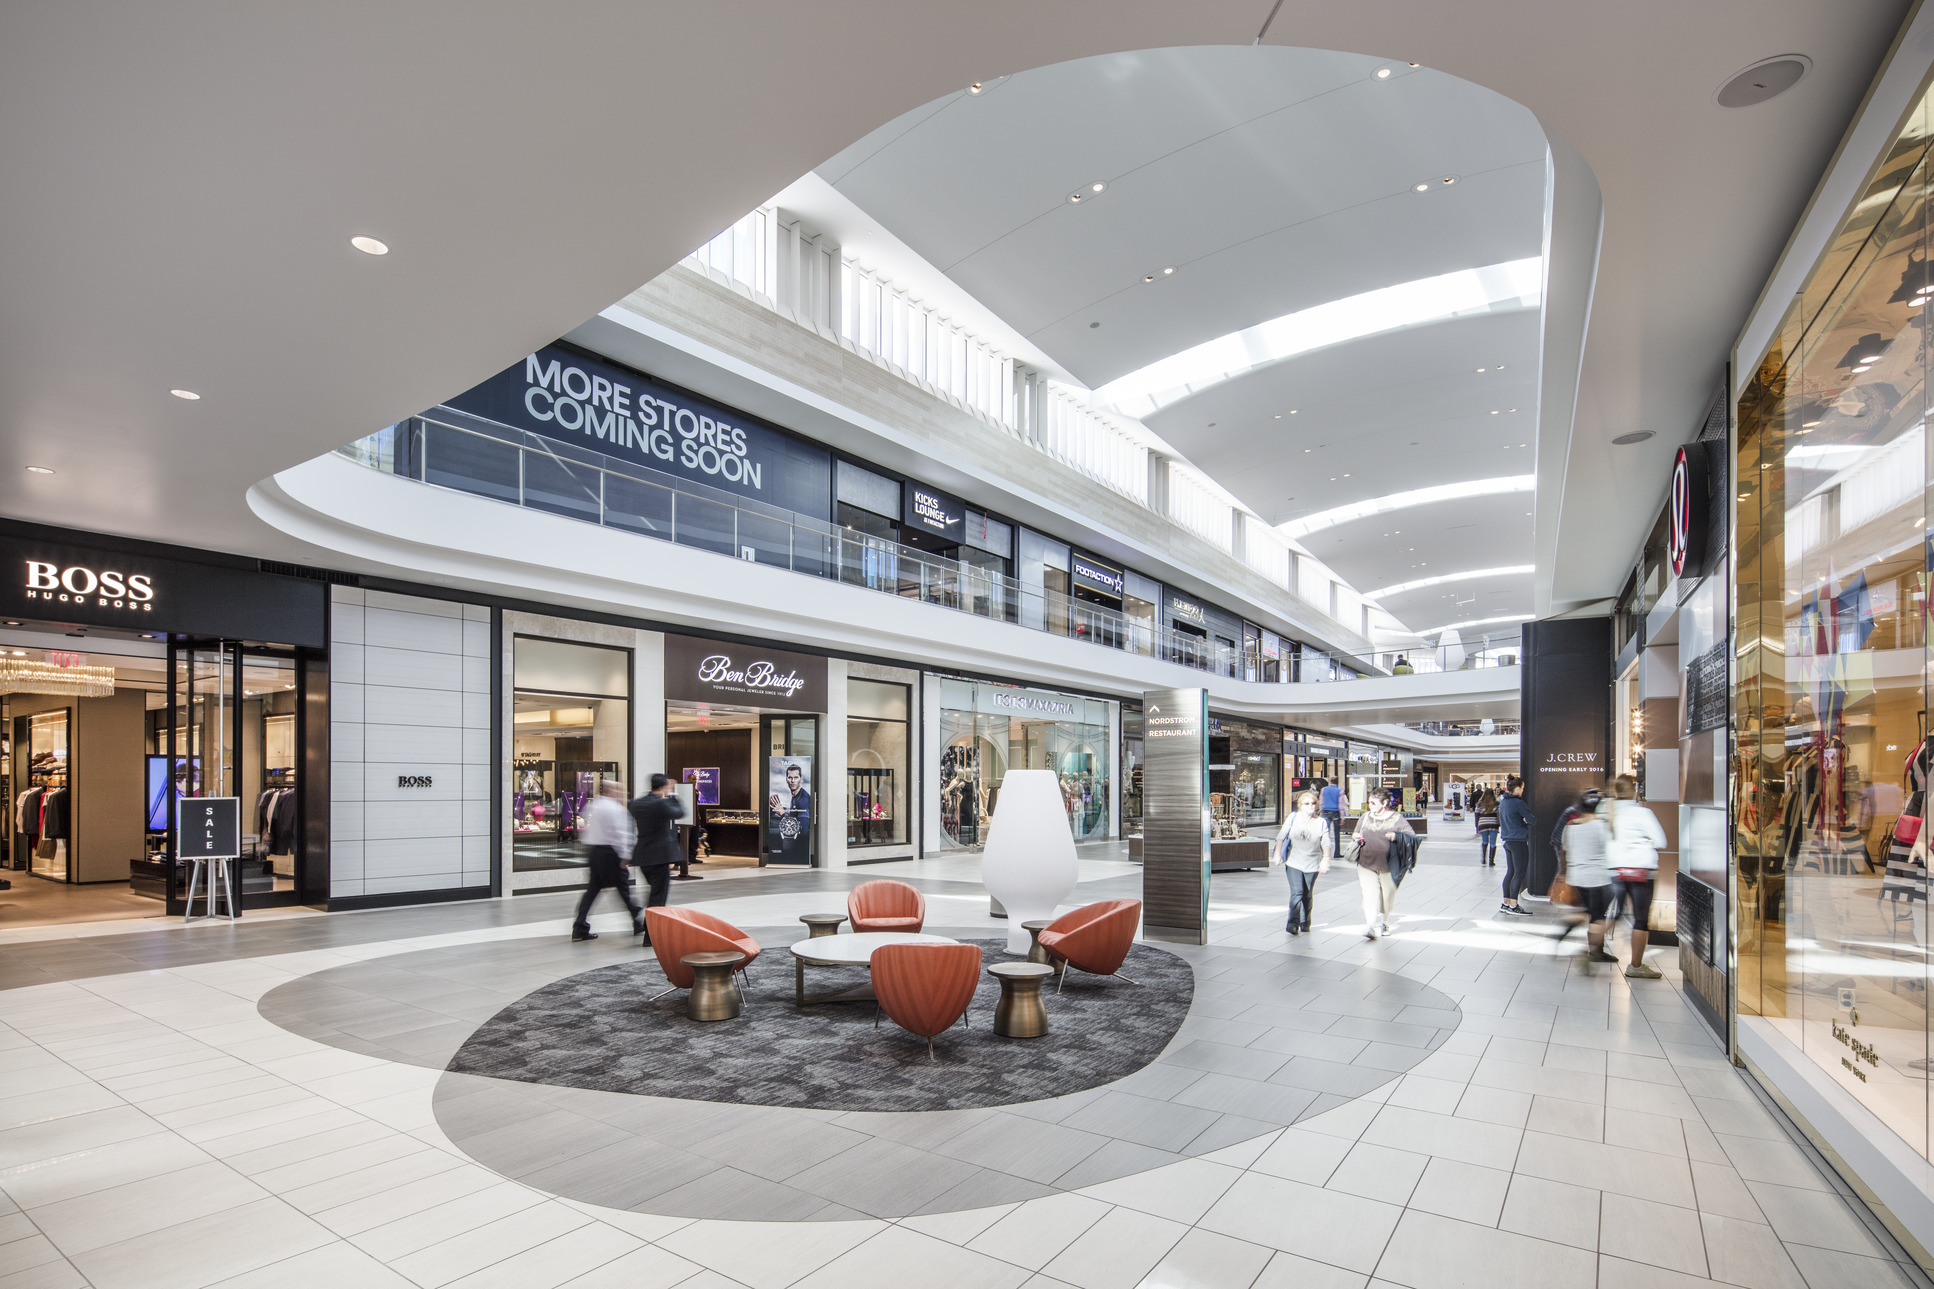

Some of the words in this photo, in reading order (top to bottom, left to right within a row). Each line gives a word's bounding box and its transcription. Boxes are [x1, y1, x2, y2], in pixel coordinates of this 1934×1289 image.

[526, 353, 631, 417] MORE
[638, 394, 748, 457] STORES
[524, 386, 674, 462] COMING
[680, 439, 762, 490] SOON
[915, 491, 938, 509] KICKS
[915, 502, 945, 522] LOUNGE
[25, 560, 154, 601] BOSS
[1075, 564, 1115, 586] FOOTACTION
[27, 590, 84, 603] HUGO
[98, 598, 152, 611] BOSS
[698, 655, 744, 682] Ben
[744, 661, 805, 697] Bridge
[1149, 715, 1196, 725] NORDSTROM
[1149, 729, 1197, 738] RESTAURANT
[1546, 753, 1598, 763] J.CREW
[398, 775, 433, 785] BOSS
[205, 807, 214, 850] SALE
[1832, 1018, 1850, 1047] kate
[1851, 1038, 1879, 1068] spade
